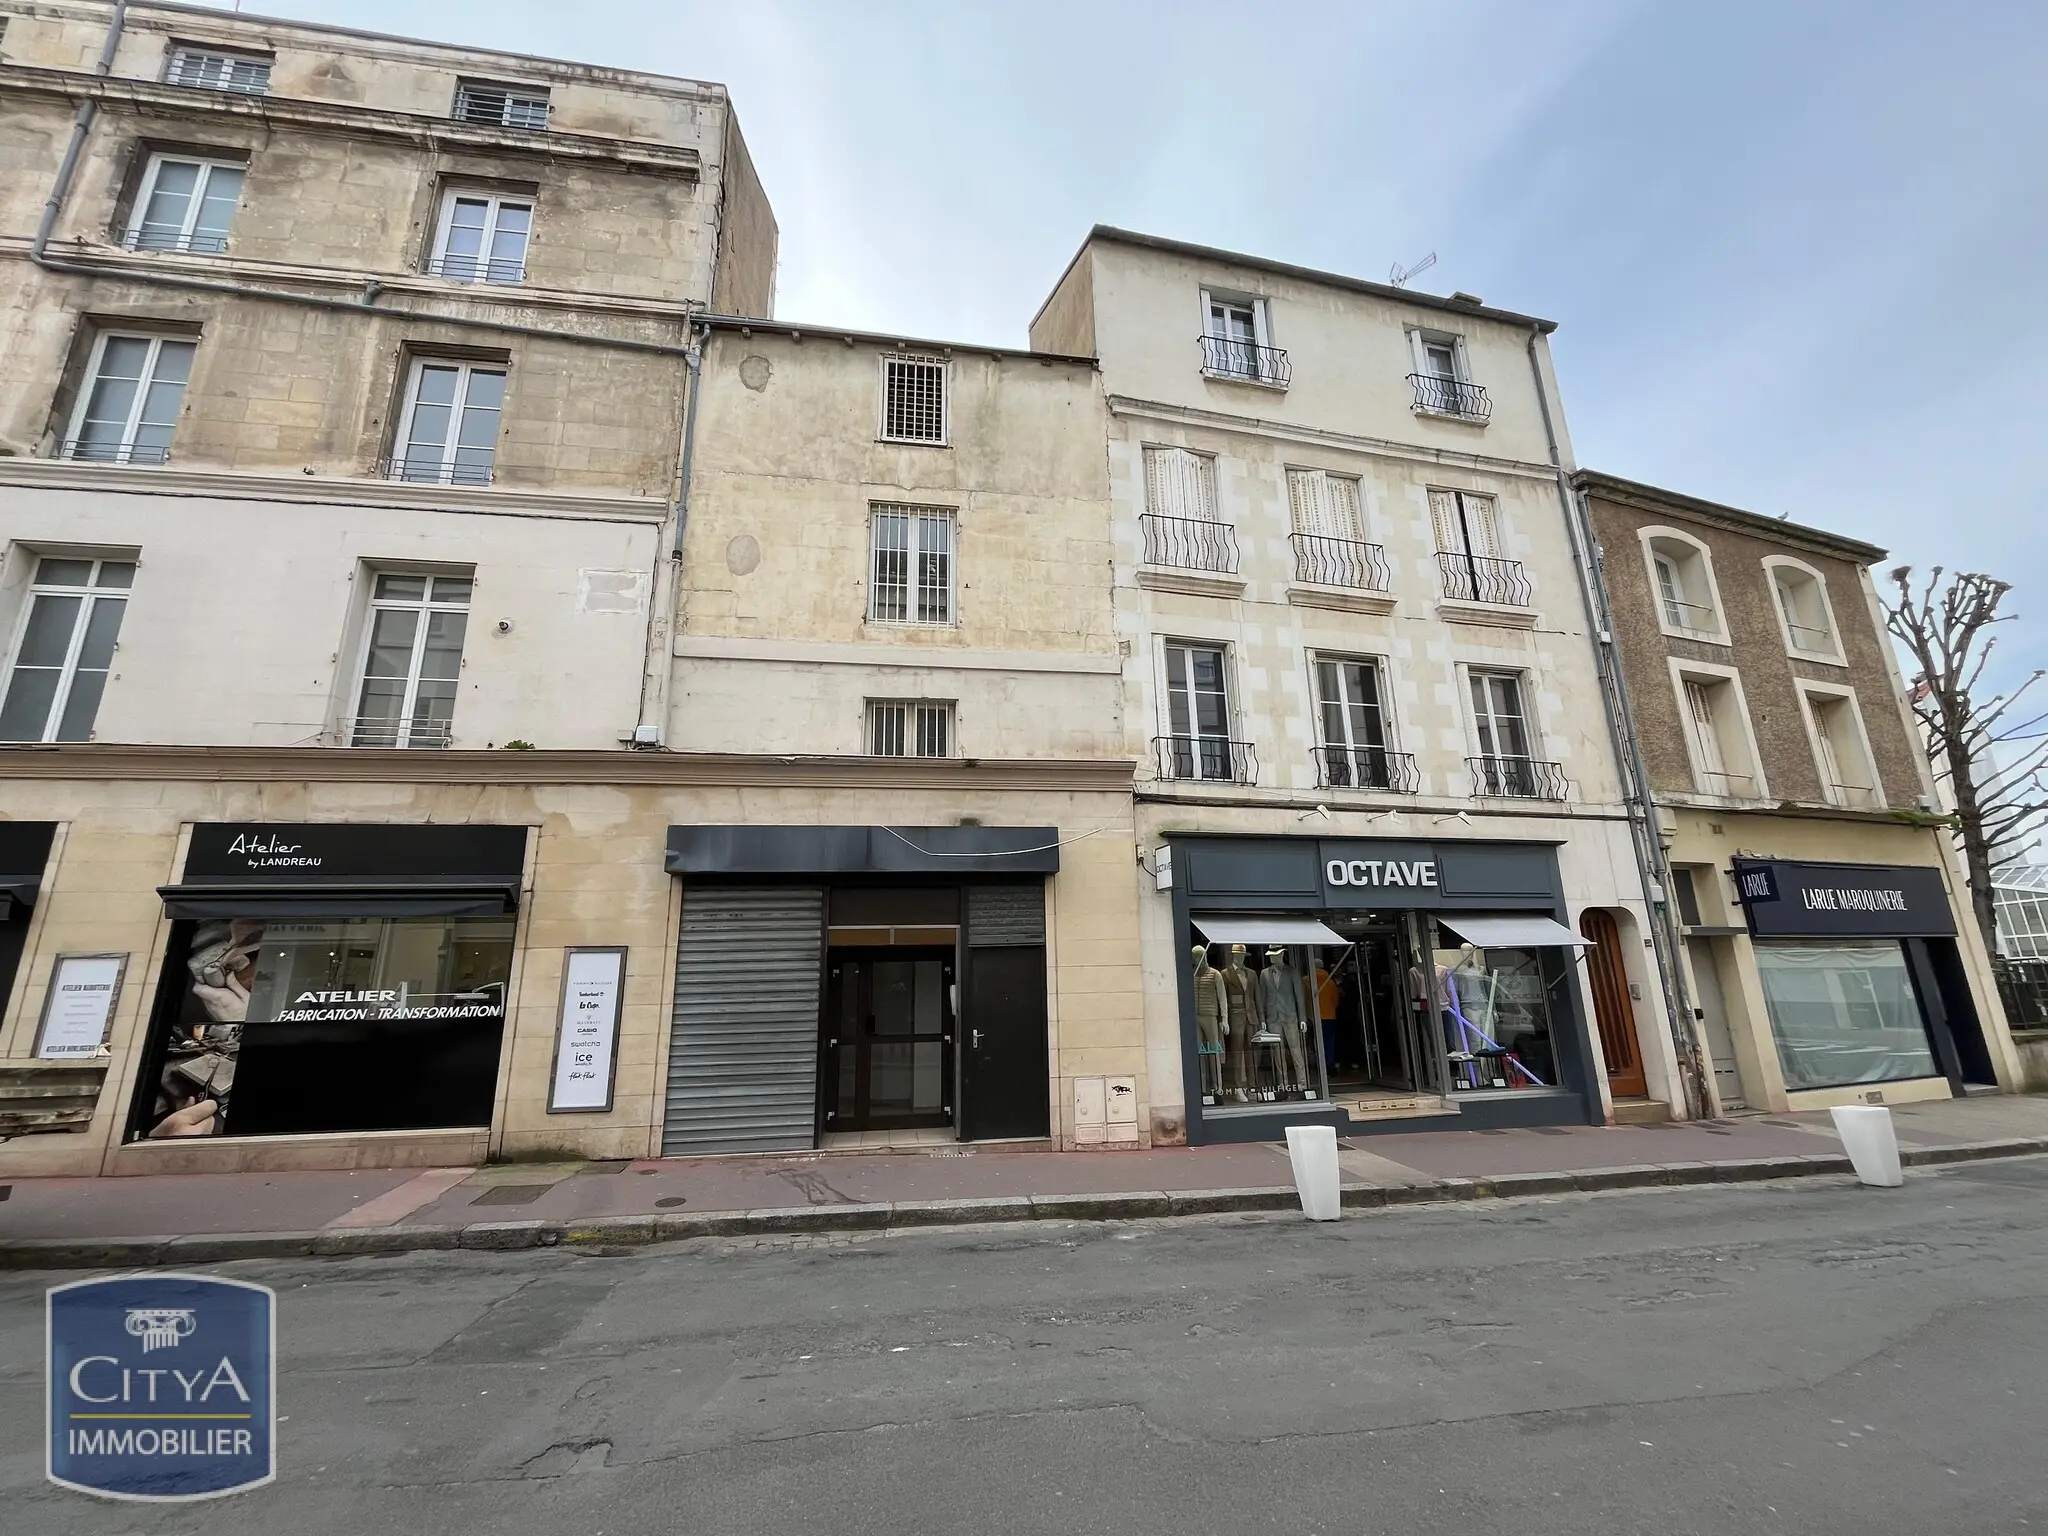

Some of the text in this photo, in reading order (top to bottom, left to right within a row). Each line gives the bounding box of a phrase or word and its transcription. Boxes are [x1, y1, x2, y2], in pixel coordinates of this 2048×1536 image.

[228, 833, 302, 855] Atelier
[248, 857, 322, 869] by LANDREAU
[1326, 860, 1438, 887] OCTAVE
[1742, 872, 1771, 897] LARUE
[1802, 888, 1908, 912] LARUE MAROQUINERIE
[295, 990, 396, 1003] ATELIER
[277, 1007, 368, 1022] FABRICATION
[377, 1005, 500, 1020] TRANSFORMATION
[575, 1052, 593, 1062] ice
[1210, 1084, 1304, 1096] TOMMY HILFIGER
